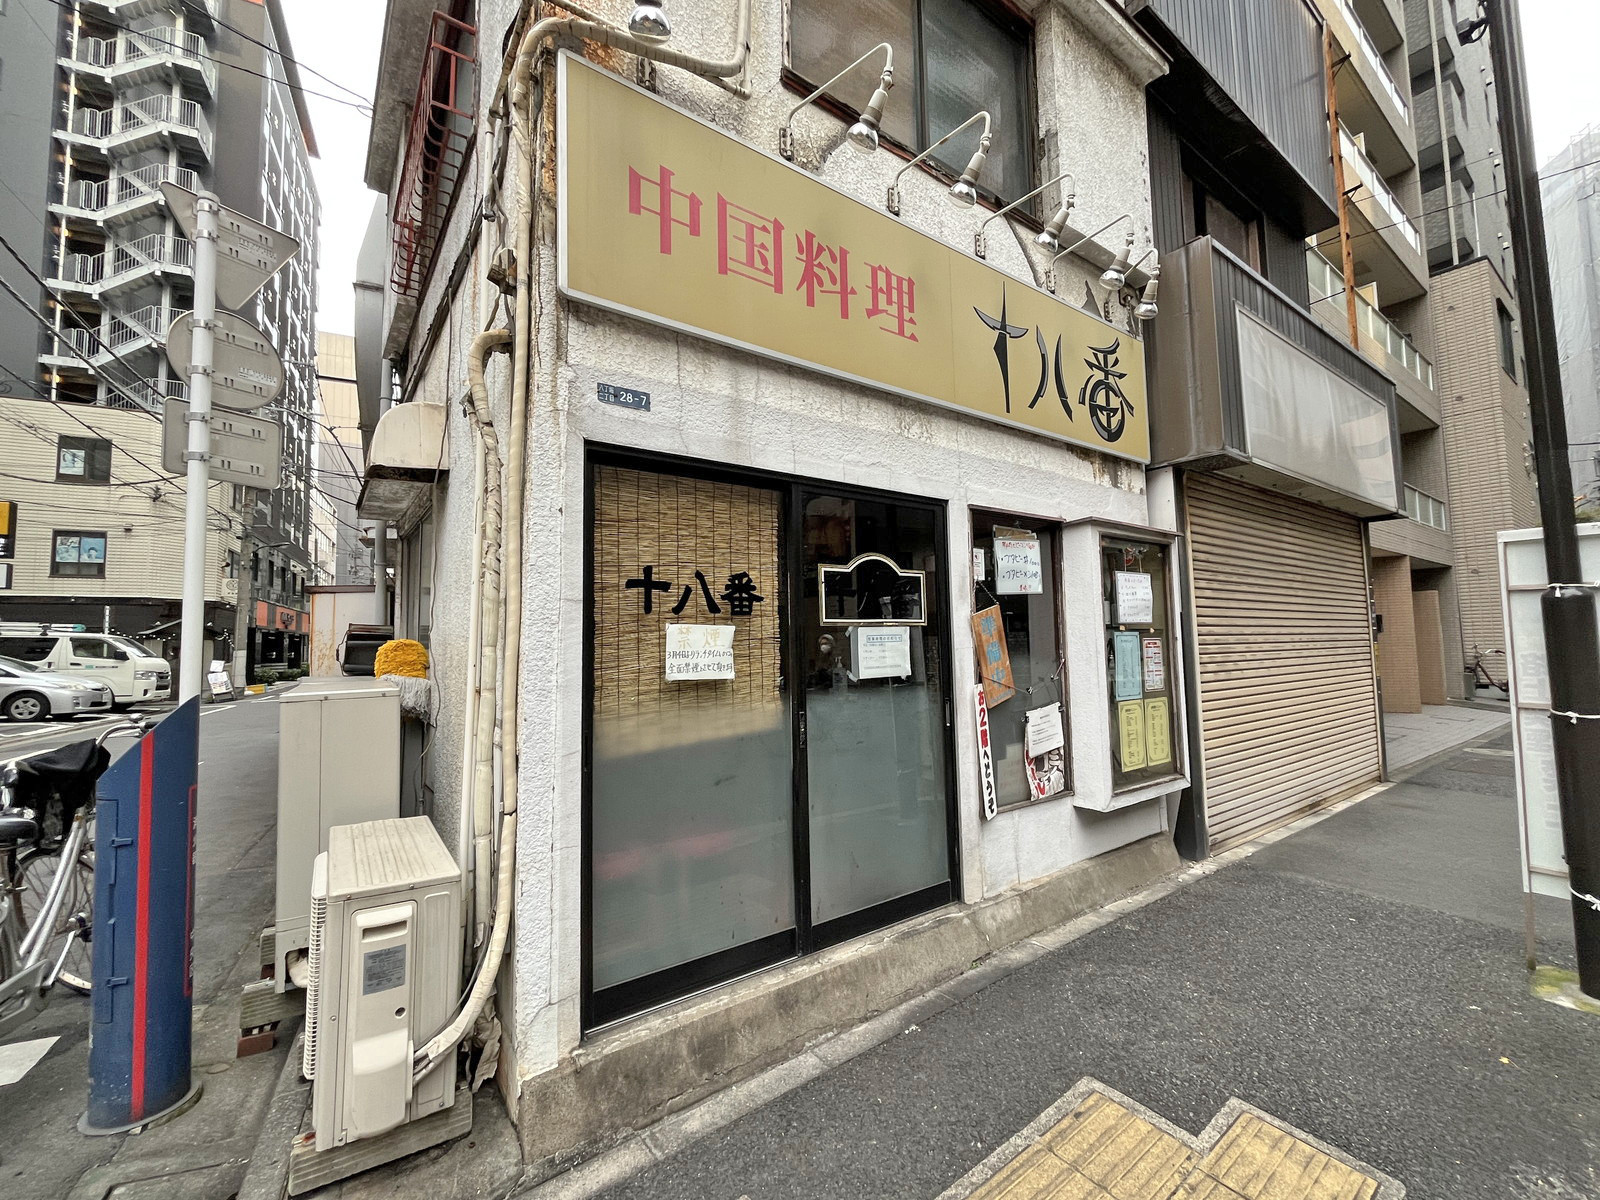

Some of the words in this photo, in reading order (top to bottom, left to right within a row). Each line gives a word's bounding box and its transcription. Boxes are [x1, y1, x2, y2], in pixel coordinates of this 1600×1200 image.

[628, 164, 919, 343] 中国料理
[619, 391, 647, 406] 28-7
[972, 281, 1135, 443] 十八番
[625, 565, 764, 616] 十八番
[676, 625, 726, 650] 禁煙
[980, 615, 1006, 688] 準備中
[977, 691, 995, 815] お2階へどうぞ
